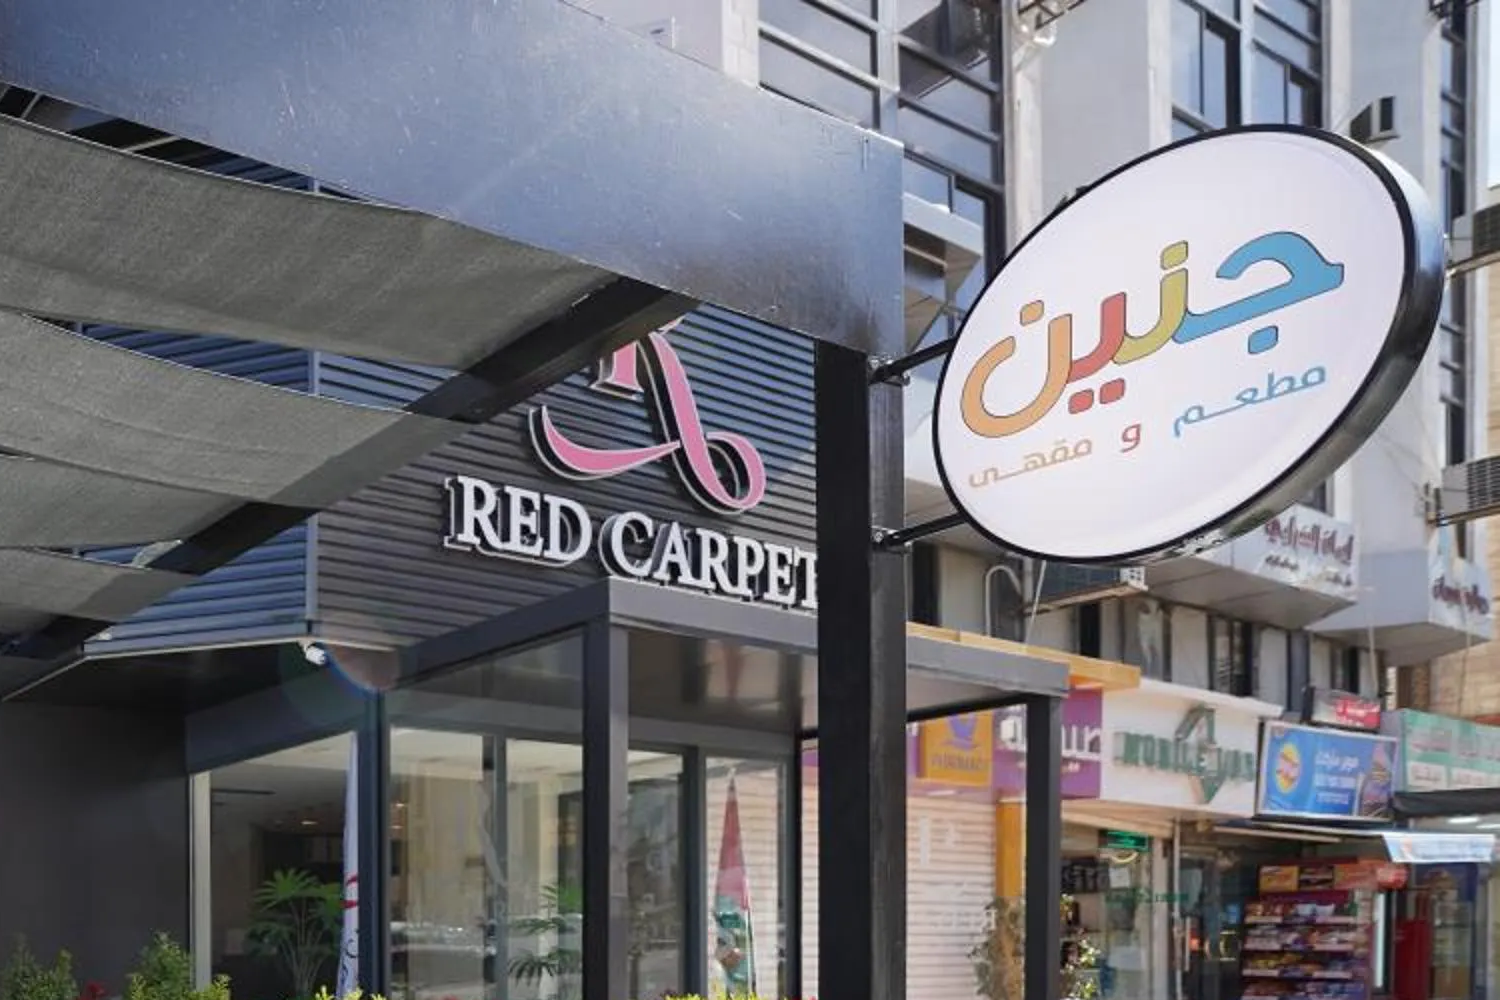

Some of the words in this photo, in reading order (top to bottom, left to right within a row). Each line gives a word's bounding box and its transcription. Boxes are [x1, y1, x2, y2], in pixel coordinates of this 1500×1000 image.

[961, 231, 1344, 438] جنين
[1174, 366, 1326, 437] مطعم
[969, 438, 1093, 488] مقهى
[1120, 423, 1141, 452] و
[446, 474, 592, 565] RED
[600, 511, 818, 608] CARPET
